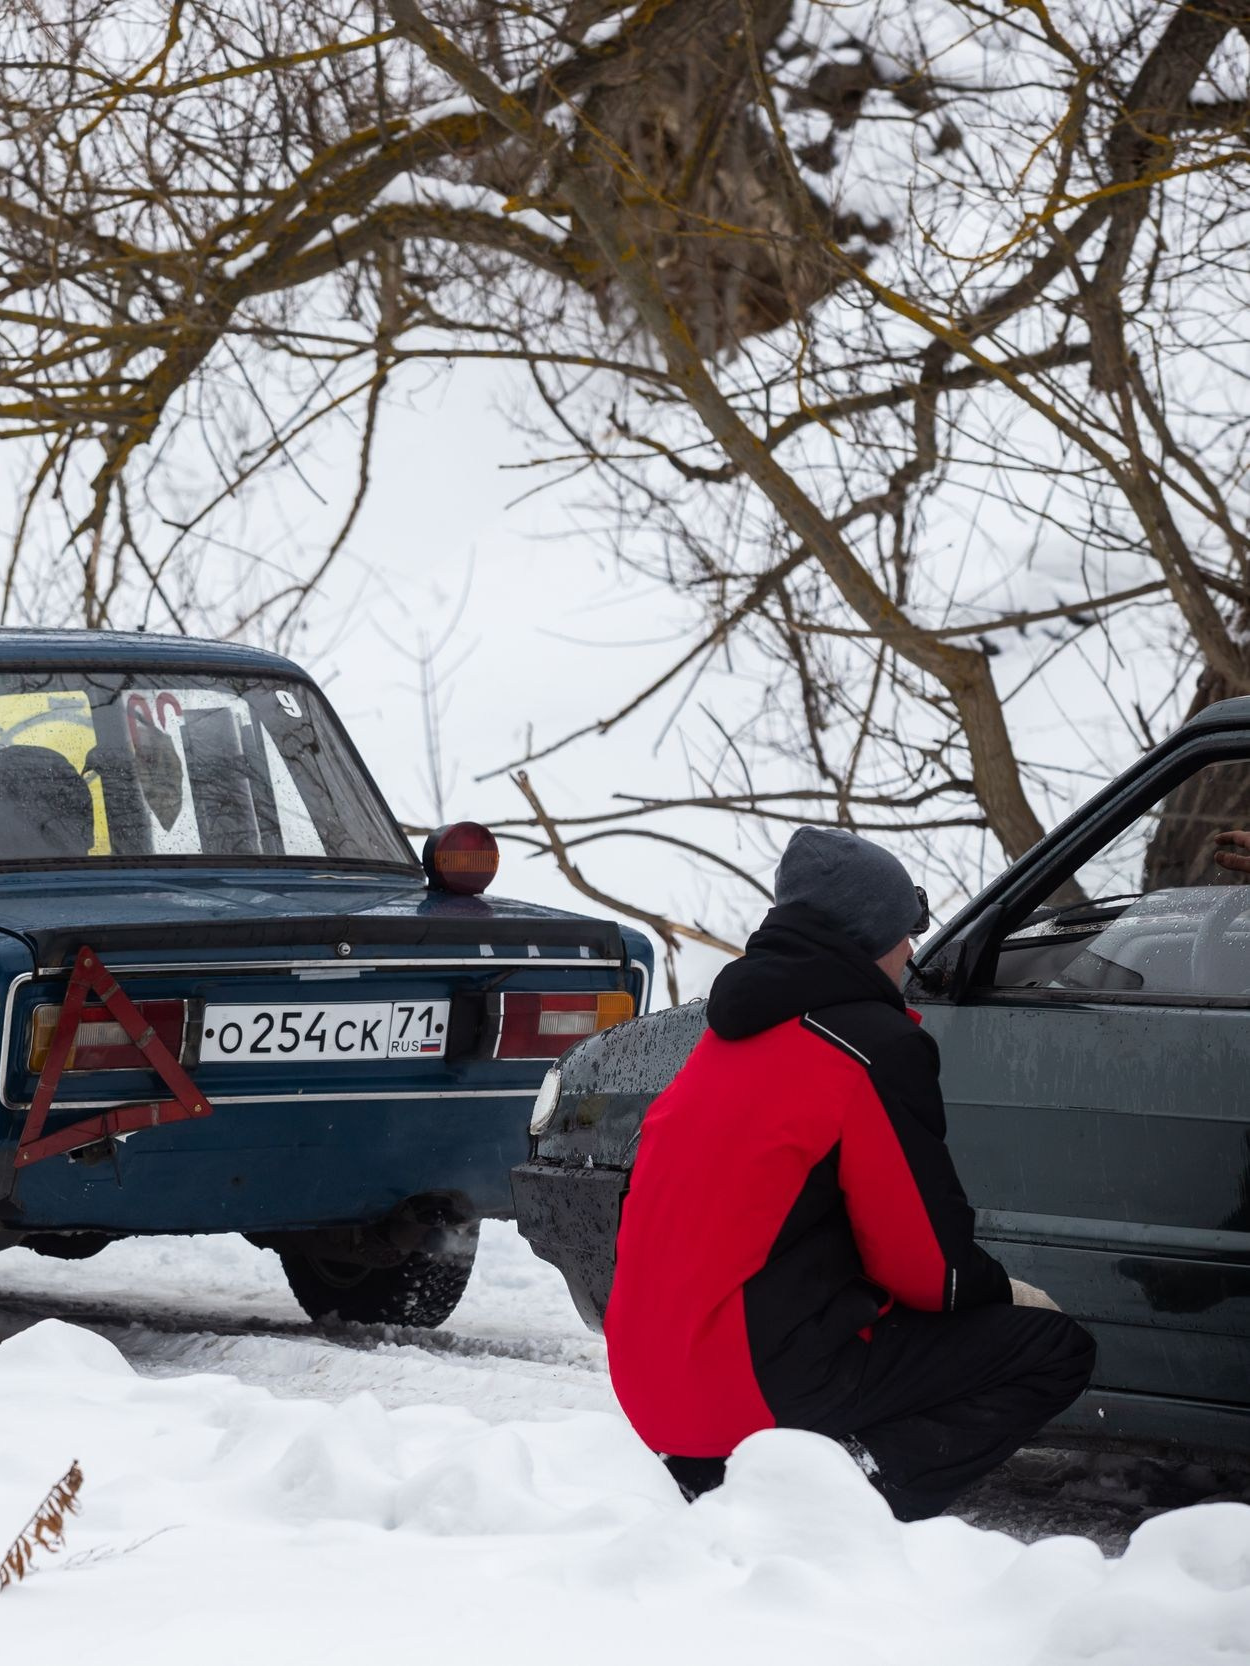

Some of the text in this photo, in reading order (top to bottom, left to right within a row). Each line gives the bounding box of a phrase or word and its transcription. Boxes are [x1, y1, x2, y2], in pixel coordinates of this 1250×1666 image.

[275, 690, 302, 718] 9
[398, 1006, 434, 1038] 71
[391, 1040, 419, 1053] RUS
